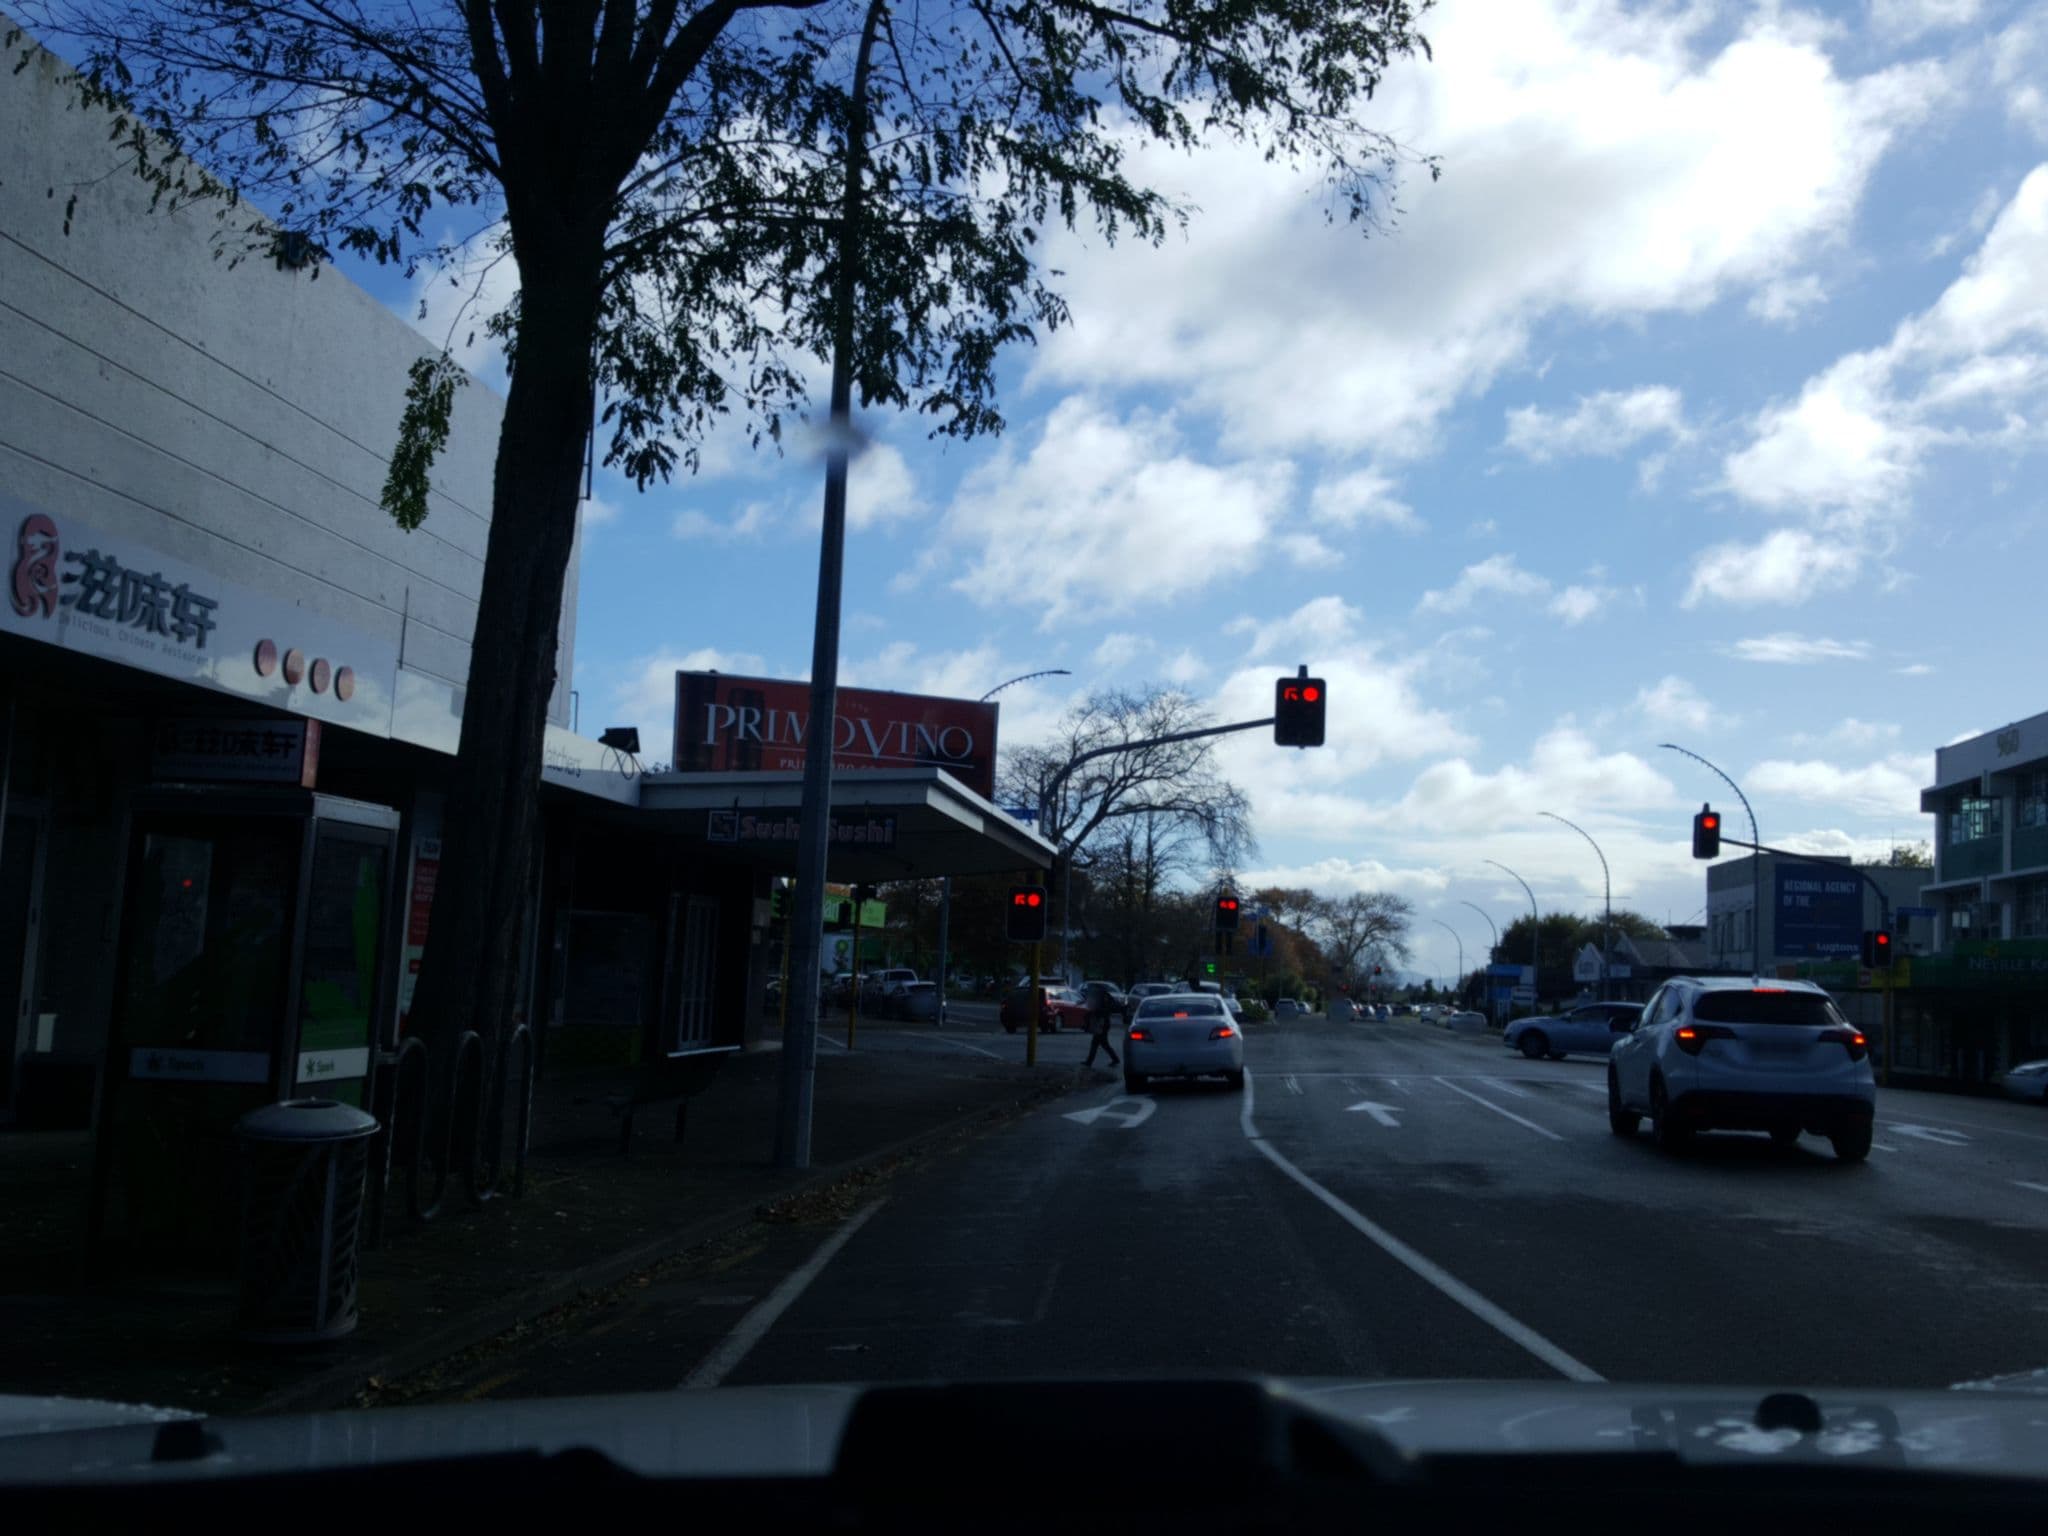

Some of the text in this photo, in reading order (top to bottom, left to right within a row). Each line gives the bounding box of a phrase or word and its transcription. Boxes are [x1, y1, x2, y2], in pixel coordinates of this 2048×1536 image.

[59, 549, 219, 649] 滋味轩
[740, 816, 799, 841] Sush
